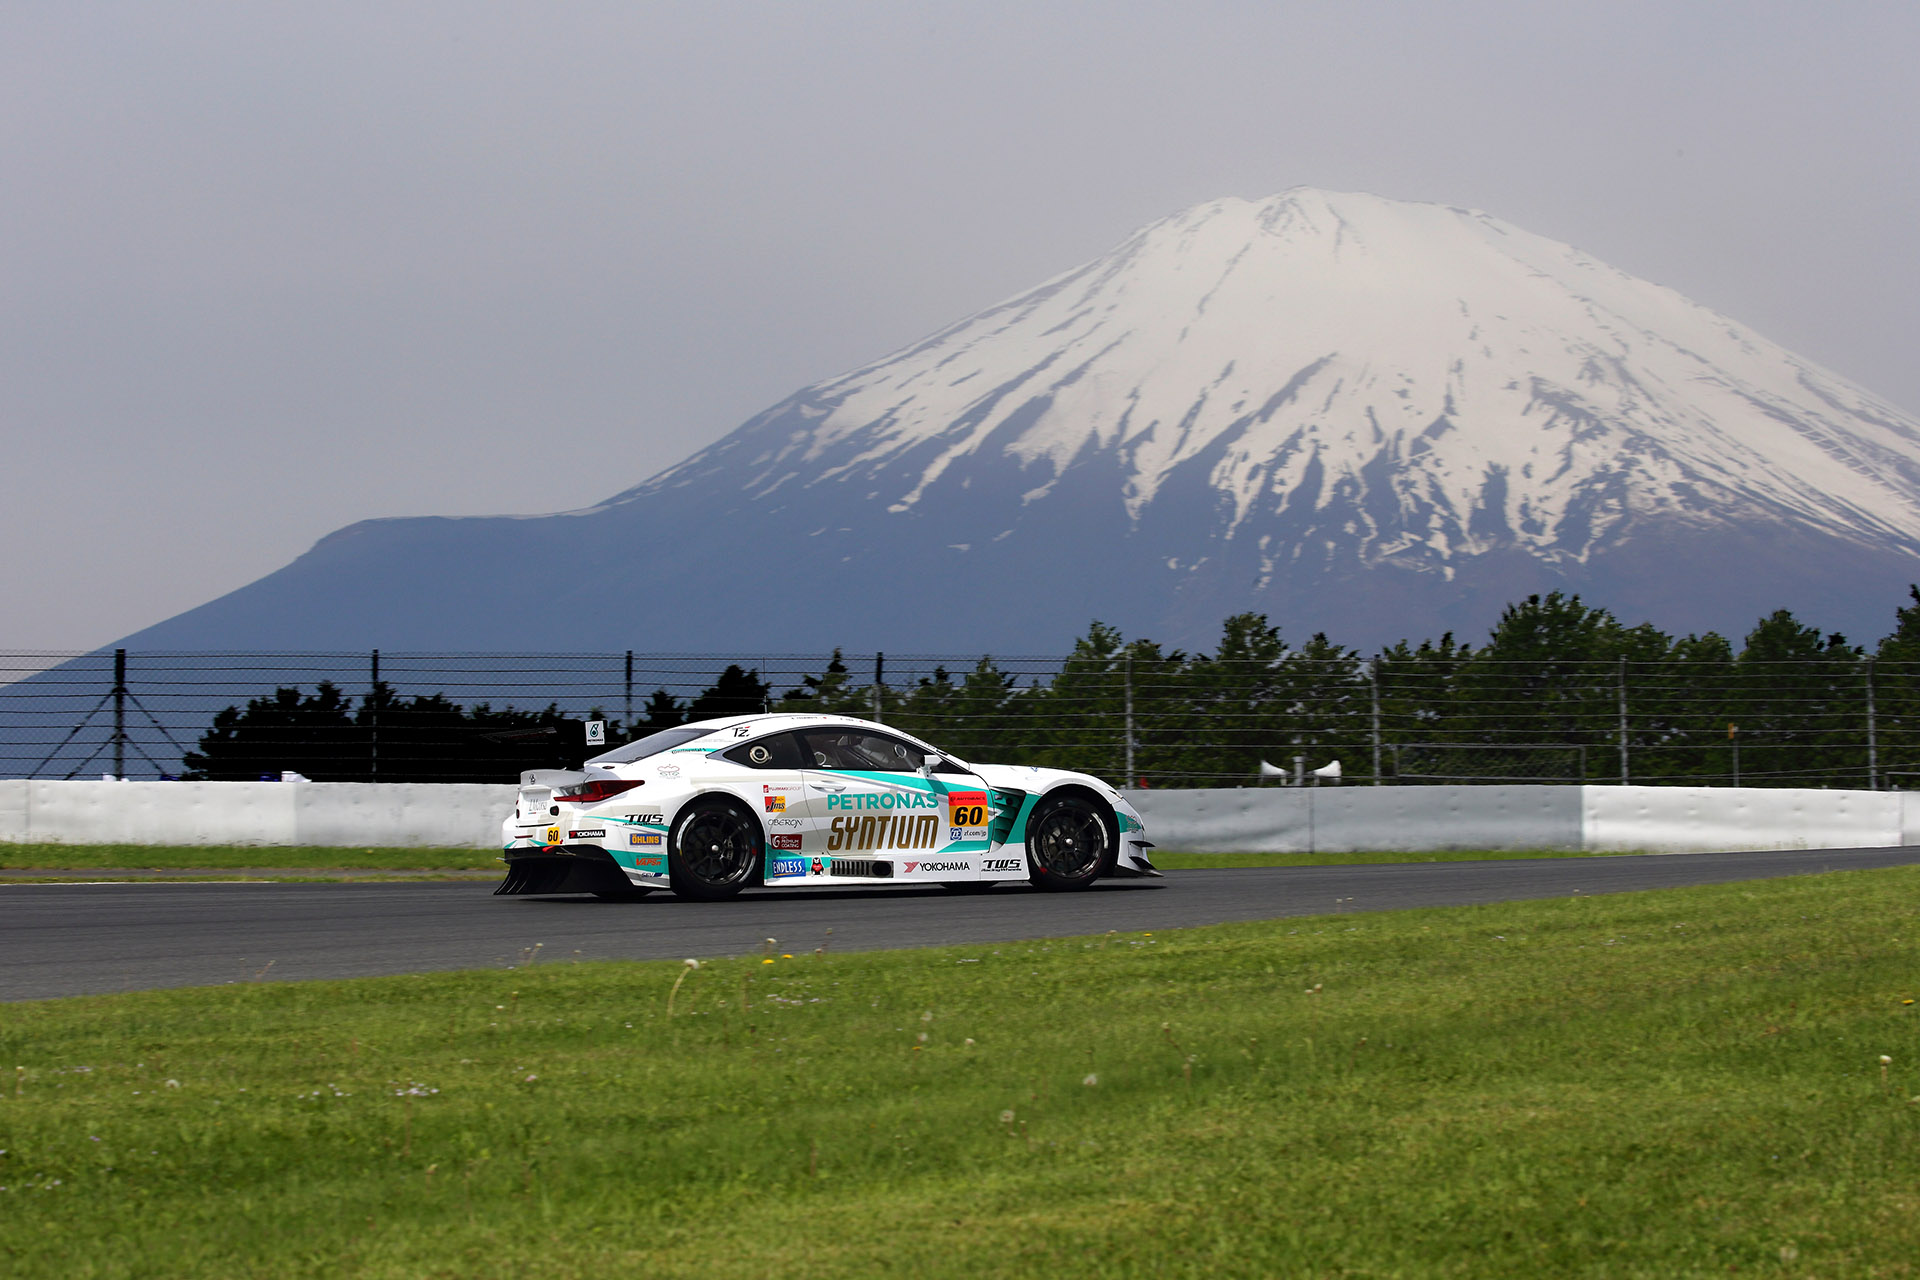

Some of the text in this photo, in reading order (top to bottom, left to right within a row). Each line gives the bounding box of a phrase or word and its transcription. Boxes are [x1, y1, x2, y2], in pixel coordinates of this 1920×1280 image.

[827, 792, 939, 811] PETRONAS
[624, 814, 664, 823] TWS
[954, 806, 983, 826] 60
[547, 830, 559, 842] 60
[827, 815, 940, 851] SYNTIUM
[632, 834, 660, 844] ÖHLINS
[919, 862, 970, 872] YOKOHAMA
[983, 859, 1021, 869] TWS
